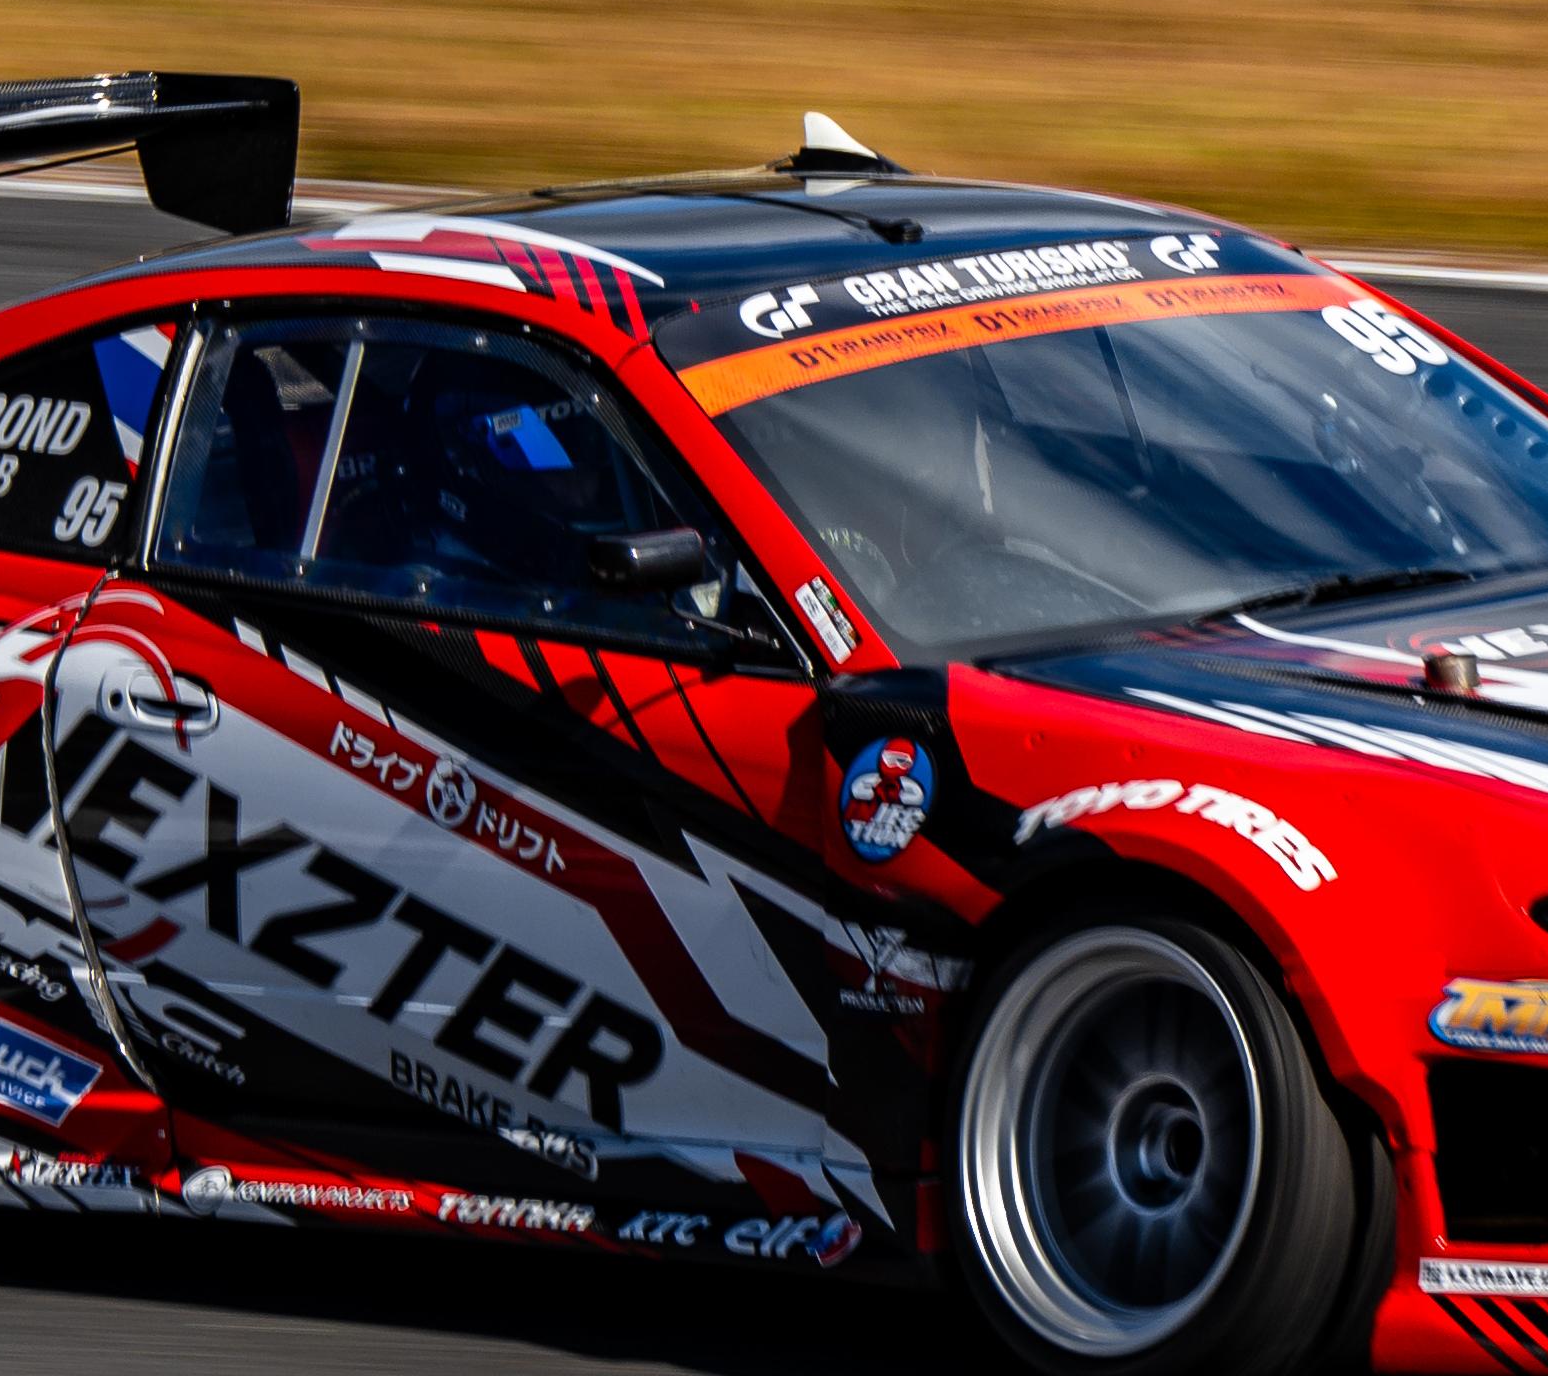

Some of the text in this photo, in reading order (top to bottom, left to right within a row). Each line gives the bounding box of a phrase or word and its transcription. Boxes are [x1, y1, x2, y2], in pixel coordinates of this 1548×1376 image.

[843, 241, 1122, 306] GRAN TURISMO
[972, 310, 1018, 333] D1
[1321, 298, 1449, 375] 95
[789, 345, 837, 370] D1
[54, 475, 129, 546] 95
[330, 720, 424, 791] ドライブ
[475, 801, 566, 874] ドリフト
[1013, 778, 1185, 846] TOYO
[1176, 784, 1339, 892] TIRES
[0, 712, 667, 1136] NEXZTER
[390, 1049, 513, 1131] BRAKE
[724, 1216, 818, 1258] elf
